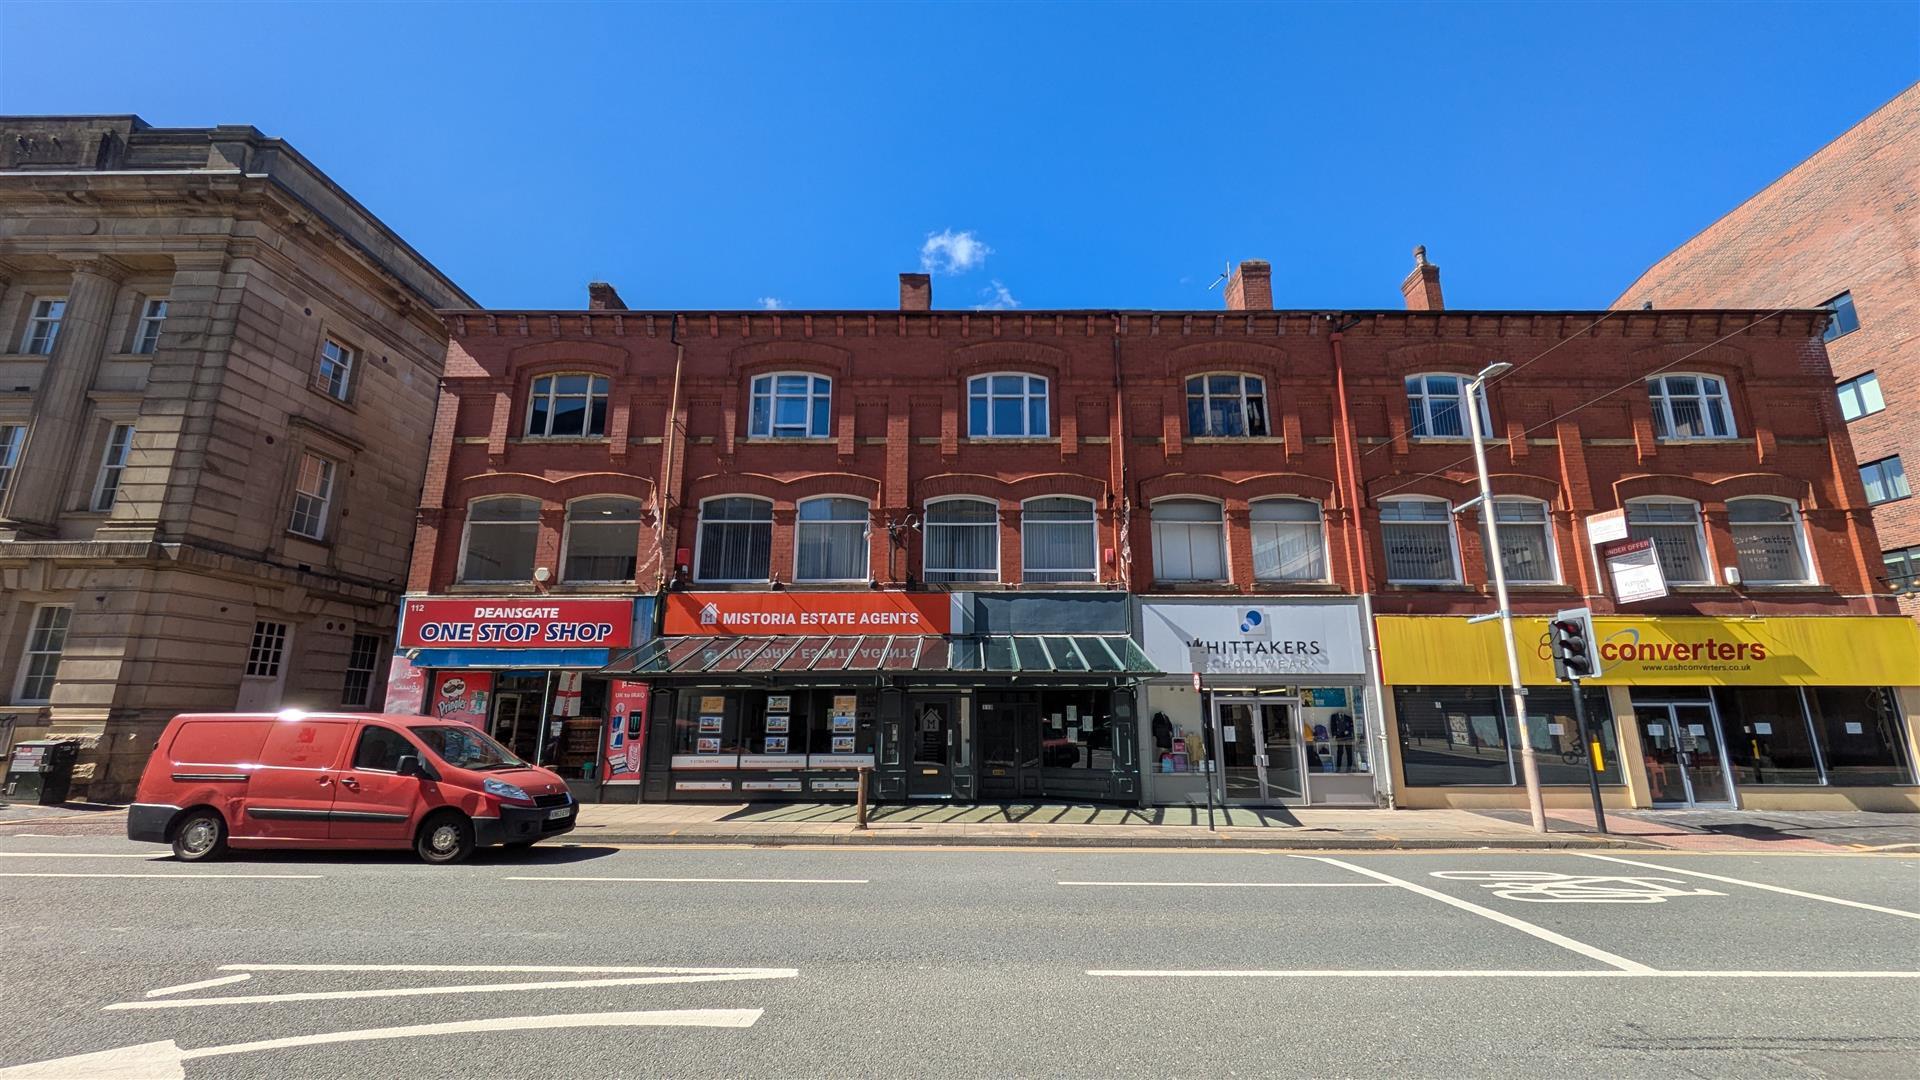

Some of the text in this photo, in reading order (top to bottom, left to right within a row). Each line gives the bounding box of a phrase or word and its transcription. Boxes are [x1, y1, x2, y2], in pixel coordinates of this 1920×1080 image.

[1606, 546, 1627, 556] UNDER
[1627, 540, 1649, 551] OFFER
[474, 607, 560, 619] DEANSGATE
[723, 613, 919, 625] MISTORIA ESTATE AGENTS
[420, 622, 613, 642] ONE STOP SHOP
[1601, 638, 1766, 661] converters
[1206, 659, 1308, 670] CHOOLWEAR
[1642, 663, 1751, 671] www.cashconverters.co.uk
